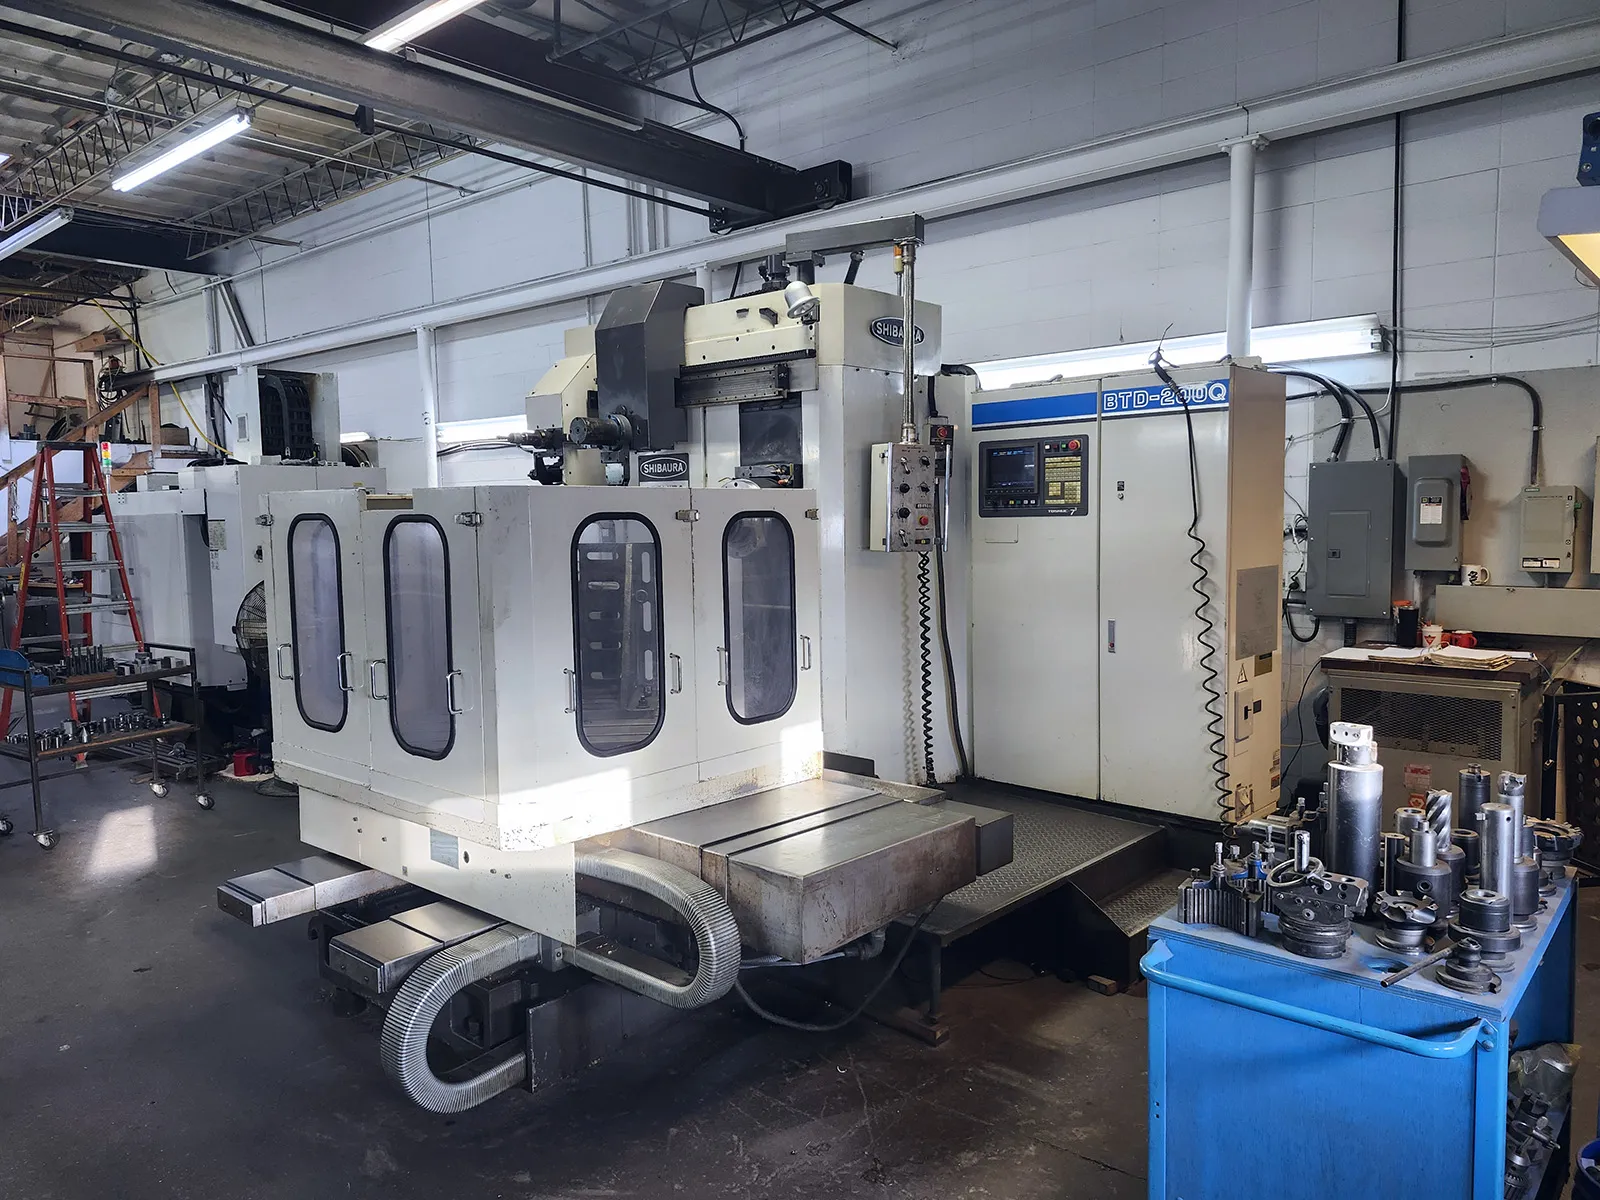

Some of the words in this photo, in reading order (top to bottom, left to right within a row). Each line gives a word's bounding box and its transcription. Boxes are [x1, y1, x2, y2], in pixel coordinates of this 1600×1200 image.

[876, 322, 922, 342] SHIBAA
[1103, 382, 1227, 411] BTD-200Q
[643, 462, 684, 474] SHIBAURA
